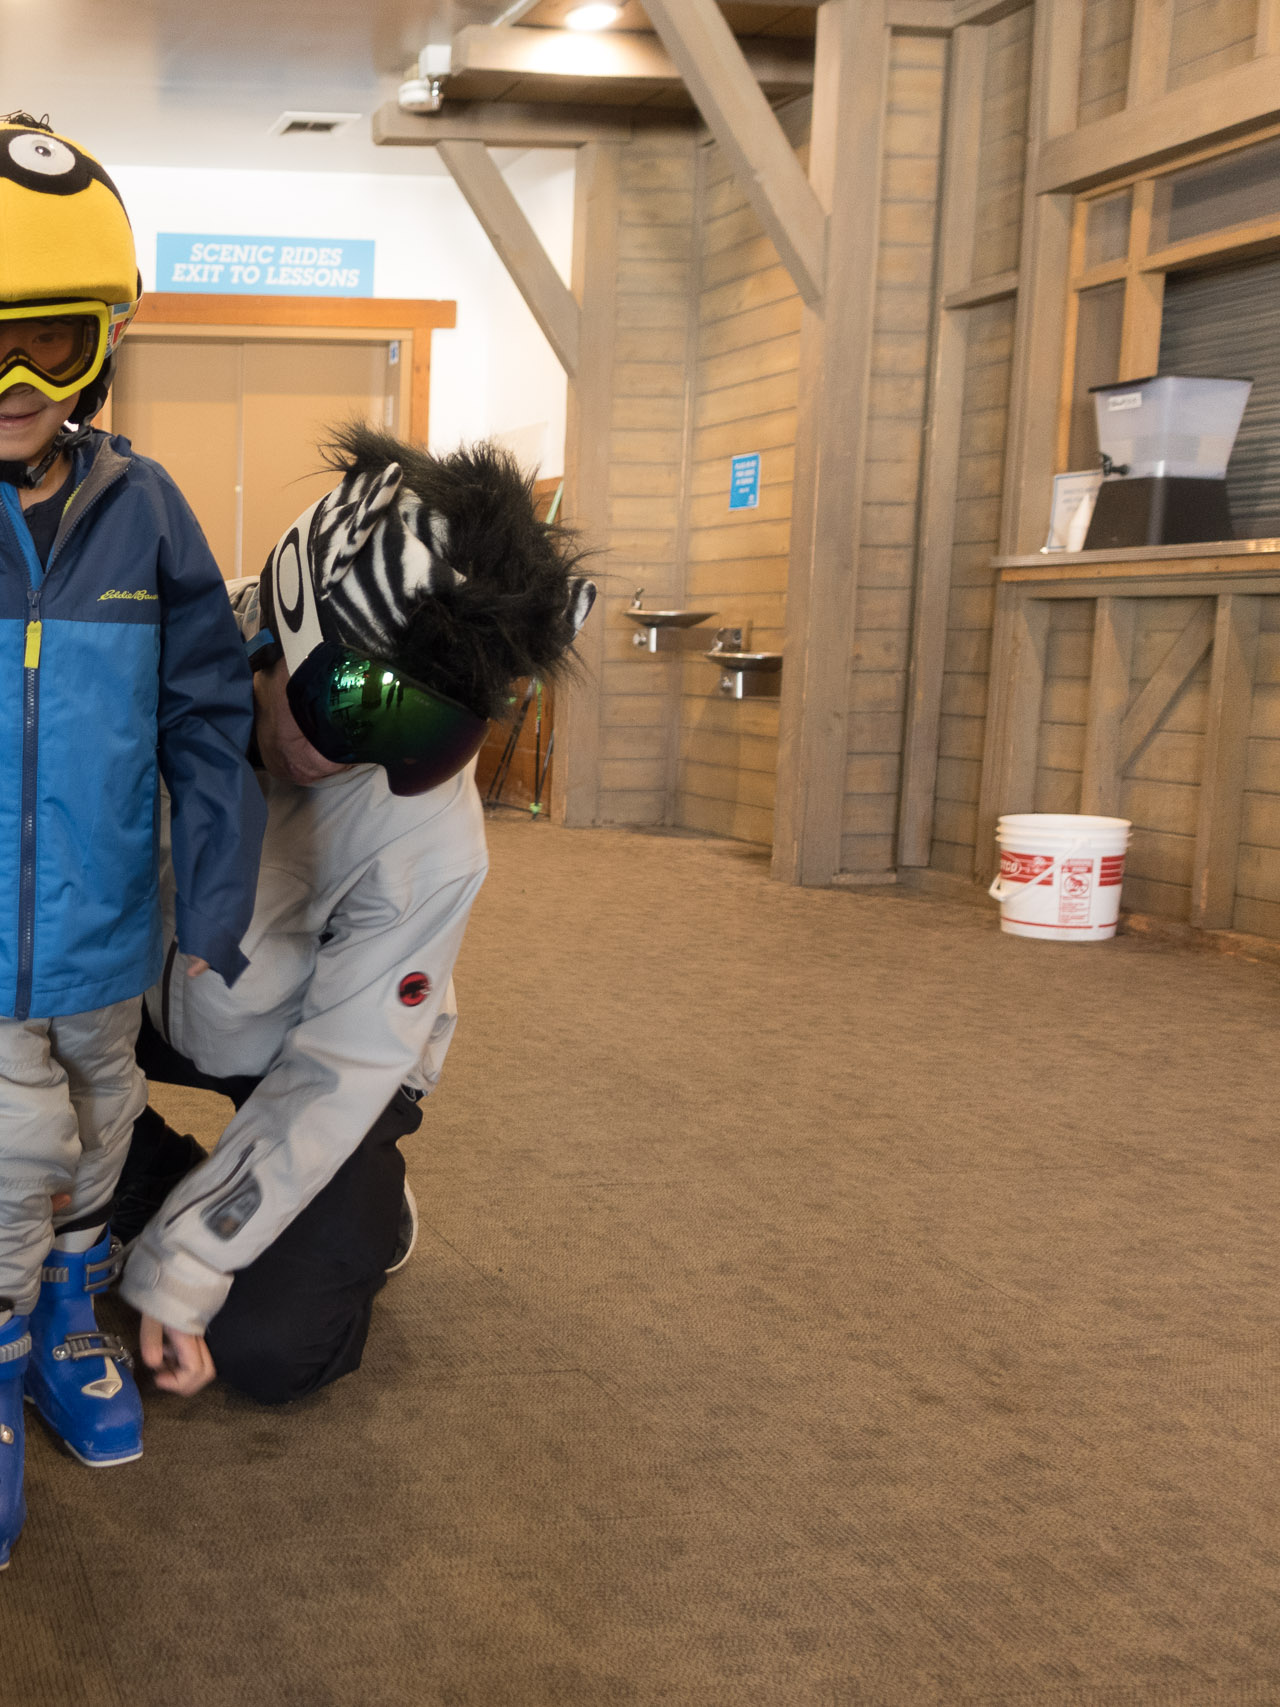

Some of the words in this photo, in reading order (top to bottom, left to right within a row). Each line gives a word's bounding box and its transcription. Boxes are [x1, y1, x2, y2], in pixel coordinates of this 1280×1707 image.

[190, 243, 274, 263] SCENIC
[279, 246, 343, 266] RIDES
[172, 263, 224, 283] EXIT
[230, 264, 261, 285] TO
[265, 267, 360, 288] LESSONS
